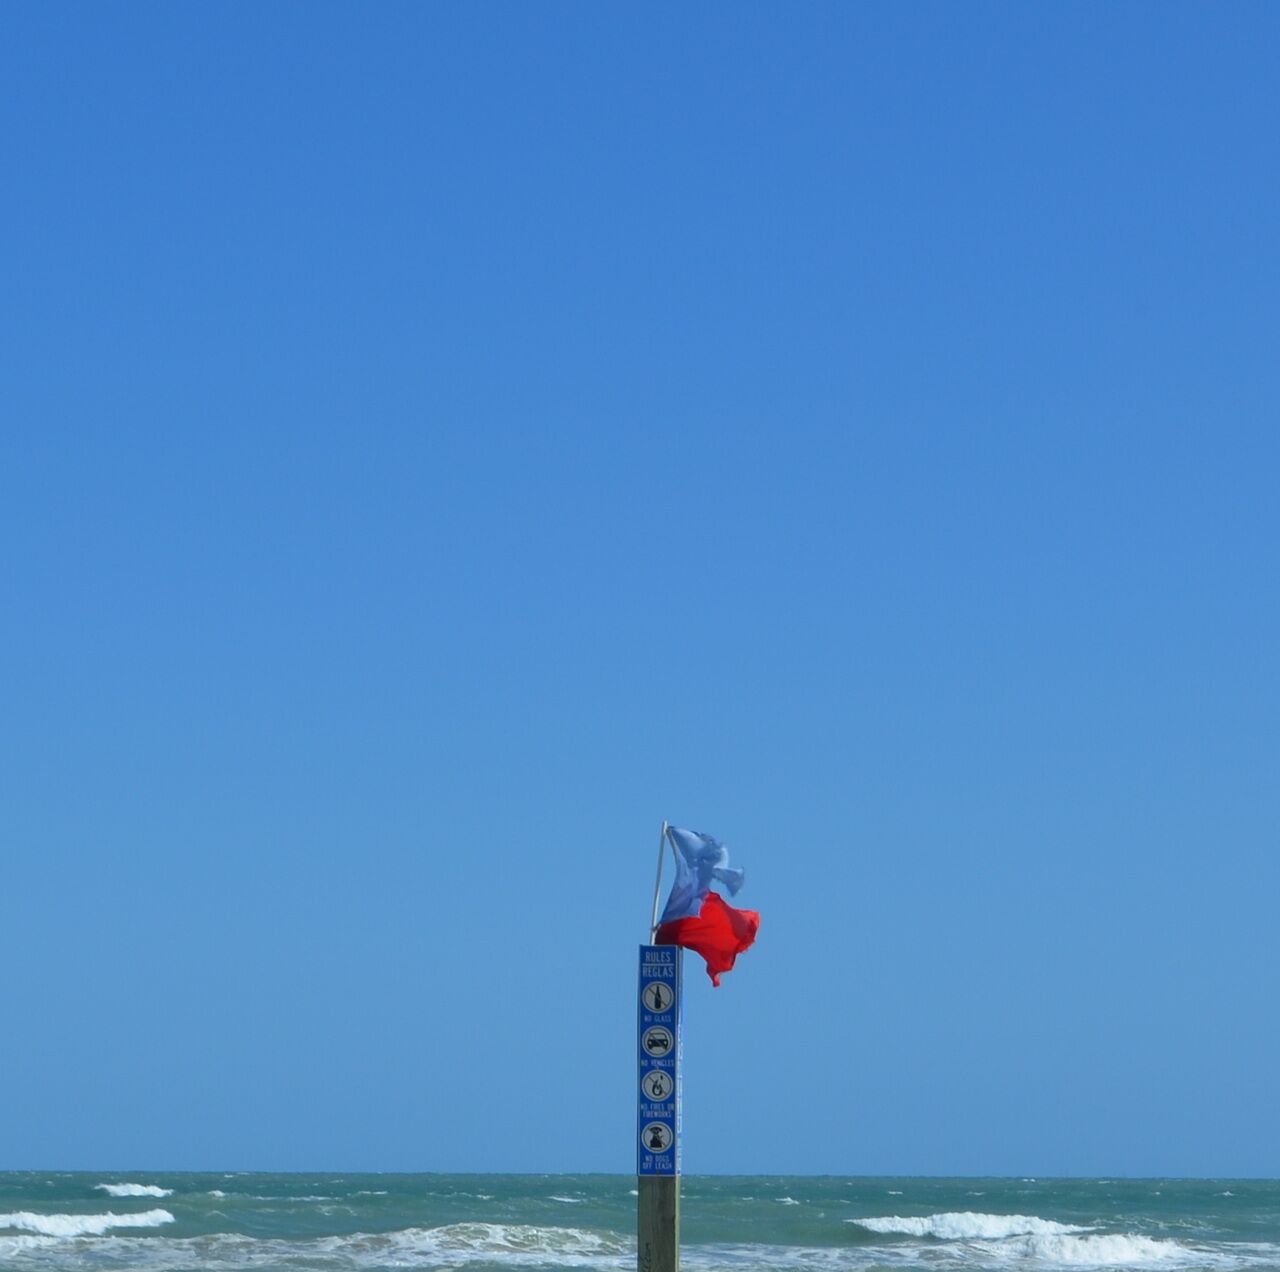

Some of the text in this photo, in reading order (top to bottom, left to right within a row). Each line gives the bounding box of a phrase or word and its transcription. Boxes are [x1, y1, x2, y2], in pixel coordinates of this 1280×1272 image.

[645, 951, 671, 962] RULES
[643, 967, 674, 977] REGLAS
[641, 1059, 649, 1067] NO
[645, 1154, 653, 1162] NO
